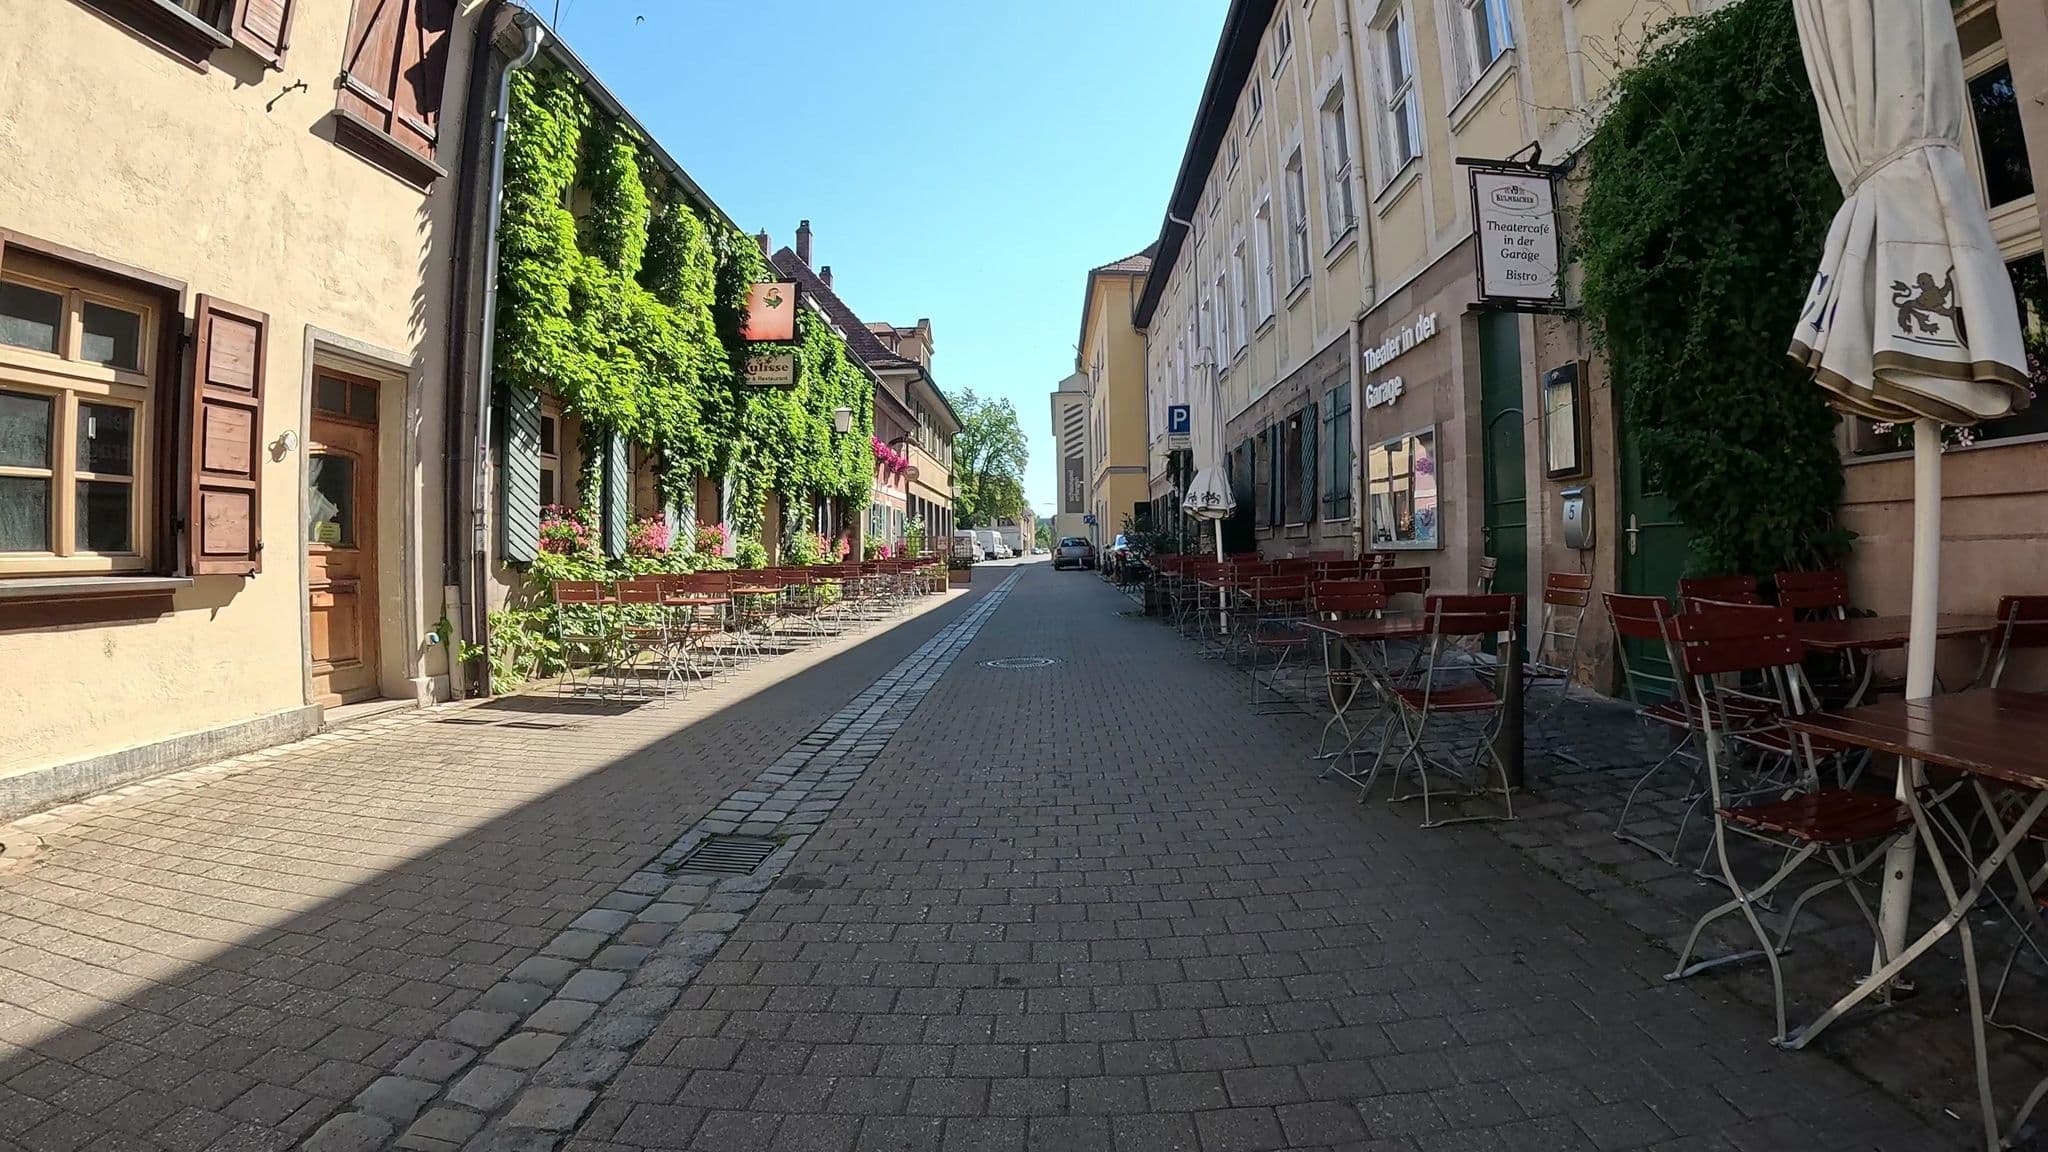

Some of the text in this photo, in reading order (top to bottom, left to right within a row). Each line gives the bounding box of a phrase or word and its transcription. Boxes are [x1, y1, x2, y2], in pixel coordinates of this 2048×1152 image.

[1486, 220, 1550, 236] Theatercafé
[1503, 235, 1535, 246] in der
[1500, 249, 1540, 262] Garage
[1505, 269, 1538, 282] Bistro
[1363, 312, 1437, 374] Theater in der
[1365, 375, 1403, 409] Garage
[1173, 408, 1187, 430] P
[1568, 504, 1576, 520] 5
